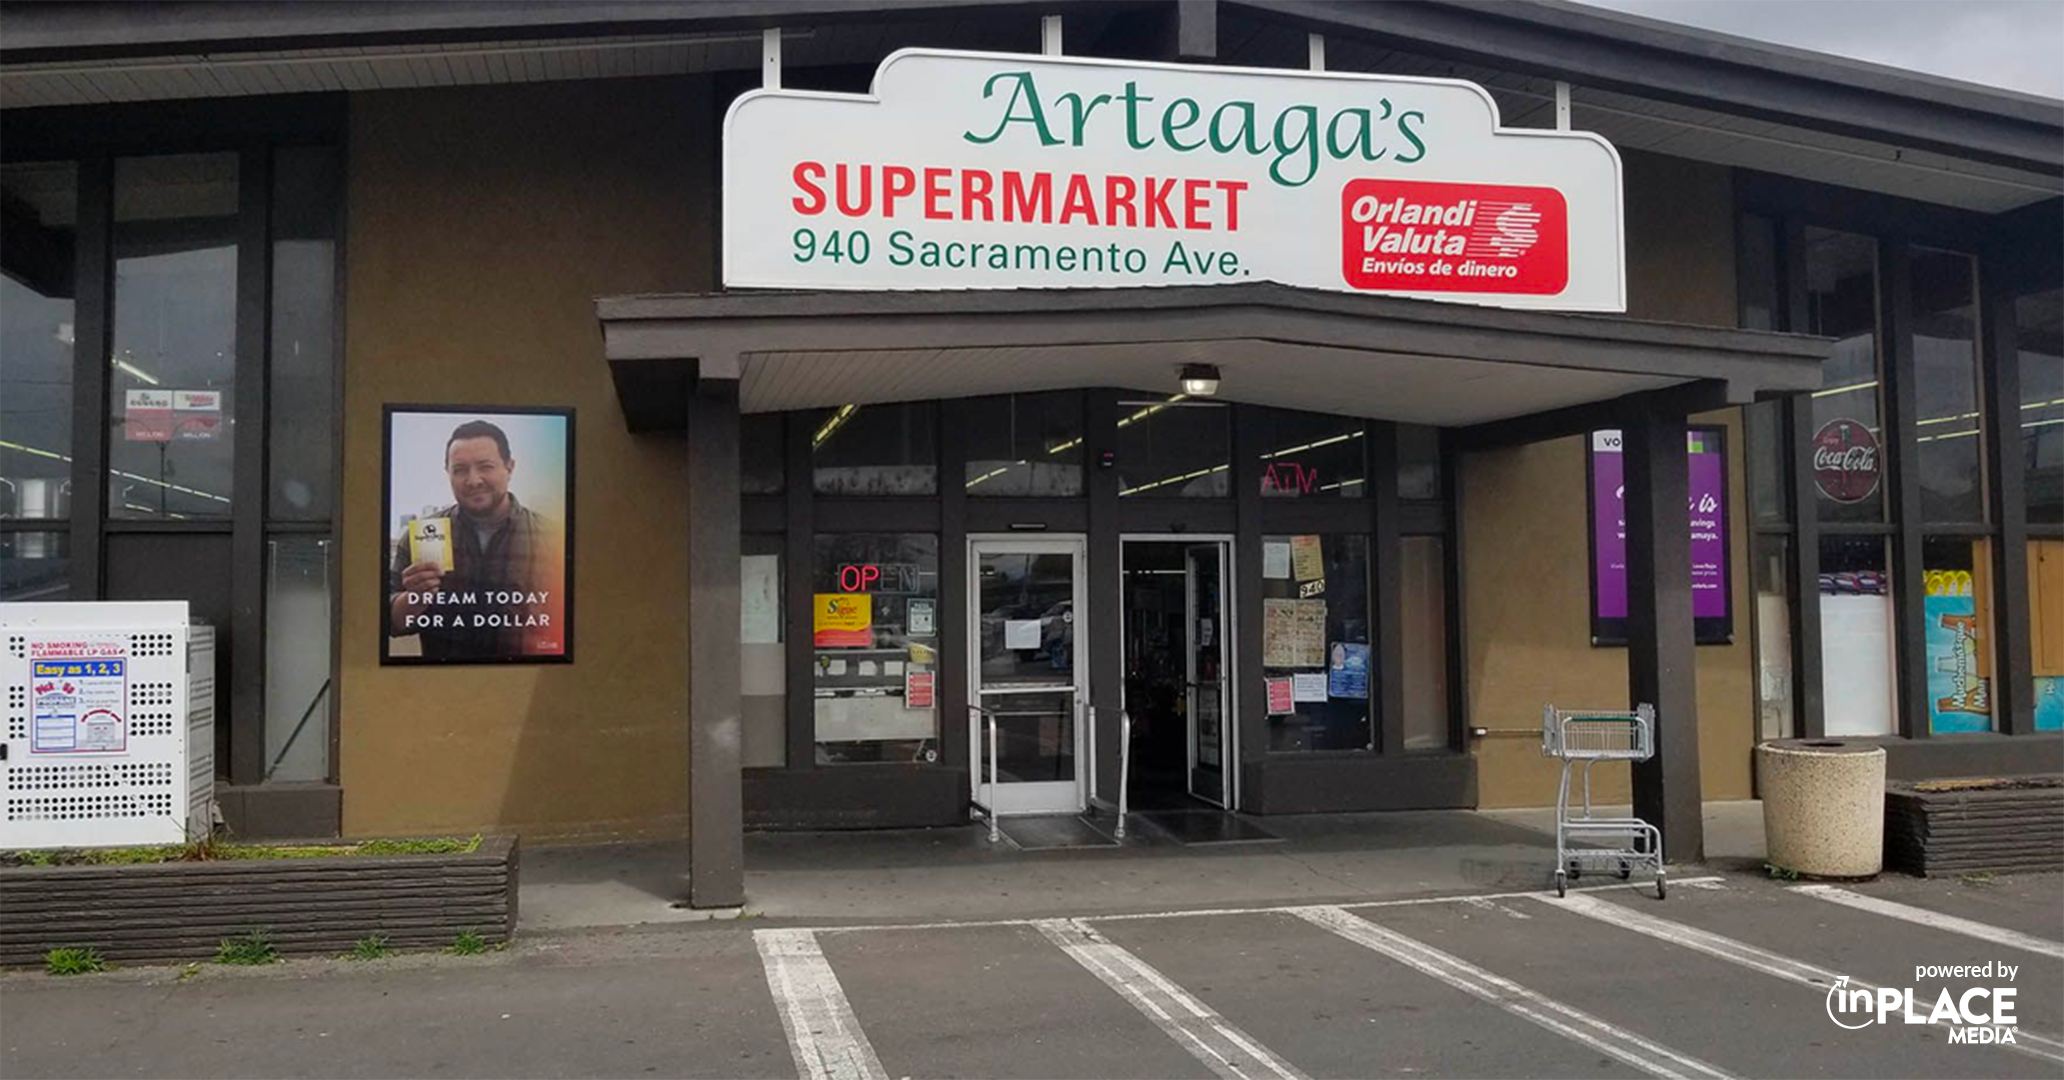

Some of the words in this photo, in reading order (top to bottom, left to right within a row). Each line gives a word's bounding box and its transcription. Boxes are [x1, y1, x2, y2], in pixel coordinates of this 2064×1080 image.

[963, 70, 1426, 187] Arteaga's
[792, 161, 1248, 231] SUPERMARKET
[1351, 196, 1477, 226] Orlandi
[793, 228, 871, 264] 940
[889, 231, 1147, 274] Sacramento
[1163, 241, 1250, 276] Ave.
[1363, 226, 1466, 255] Valuta
[1362, 257, 1425, 275] Envíos
[1429, 260, 1452, 275] de
[1458, 261, 1518, 278] dinero
[1261, 463, 1317, 494] ATM
[841, 565, 916, 592] OPEN
[1301, 580, 1324, 596] 940
[408, 591, 476, 605] DREAM
[486, 591, 549, 604] TODAY
[405, 614, 443, 627] FOR
[452, 614, 465, 627] A
[474, 614, 550, 627] DOLLAR
[36, 664, 65, 677] Easy
[68, 665, 82, 674] as
[113, 663, 120, 673] 3
